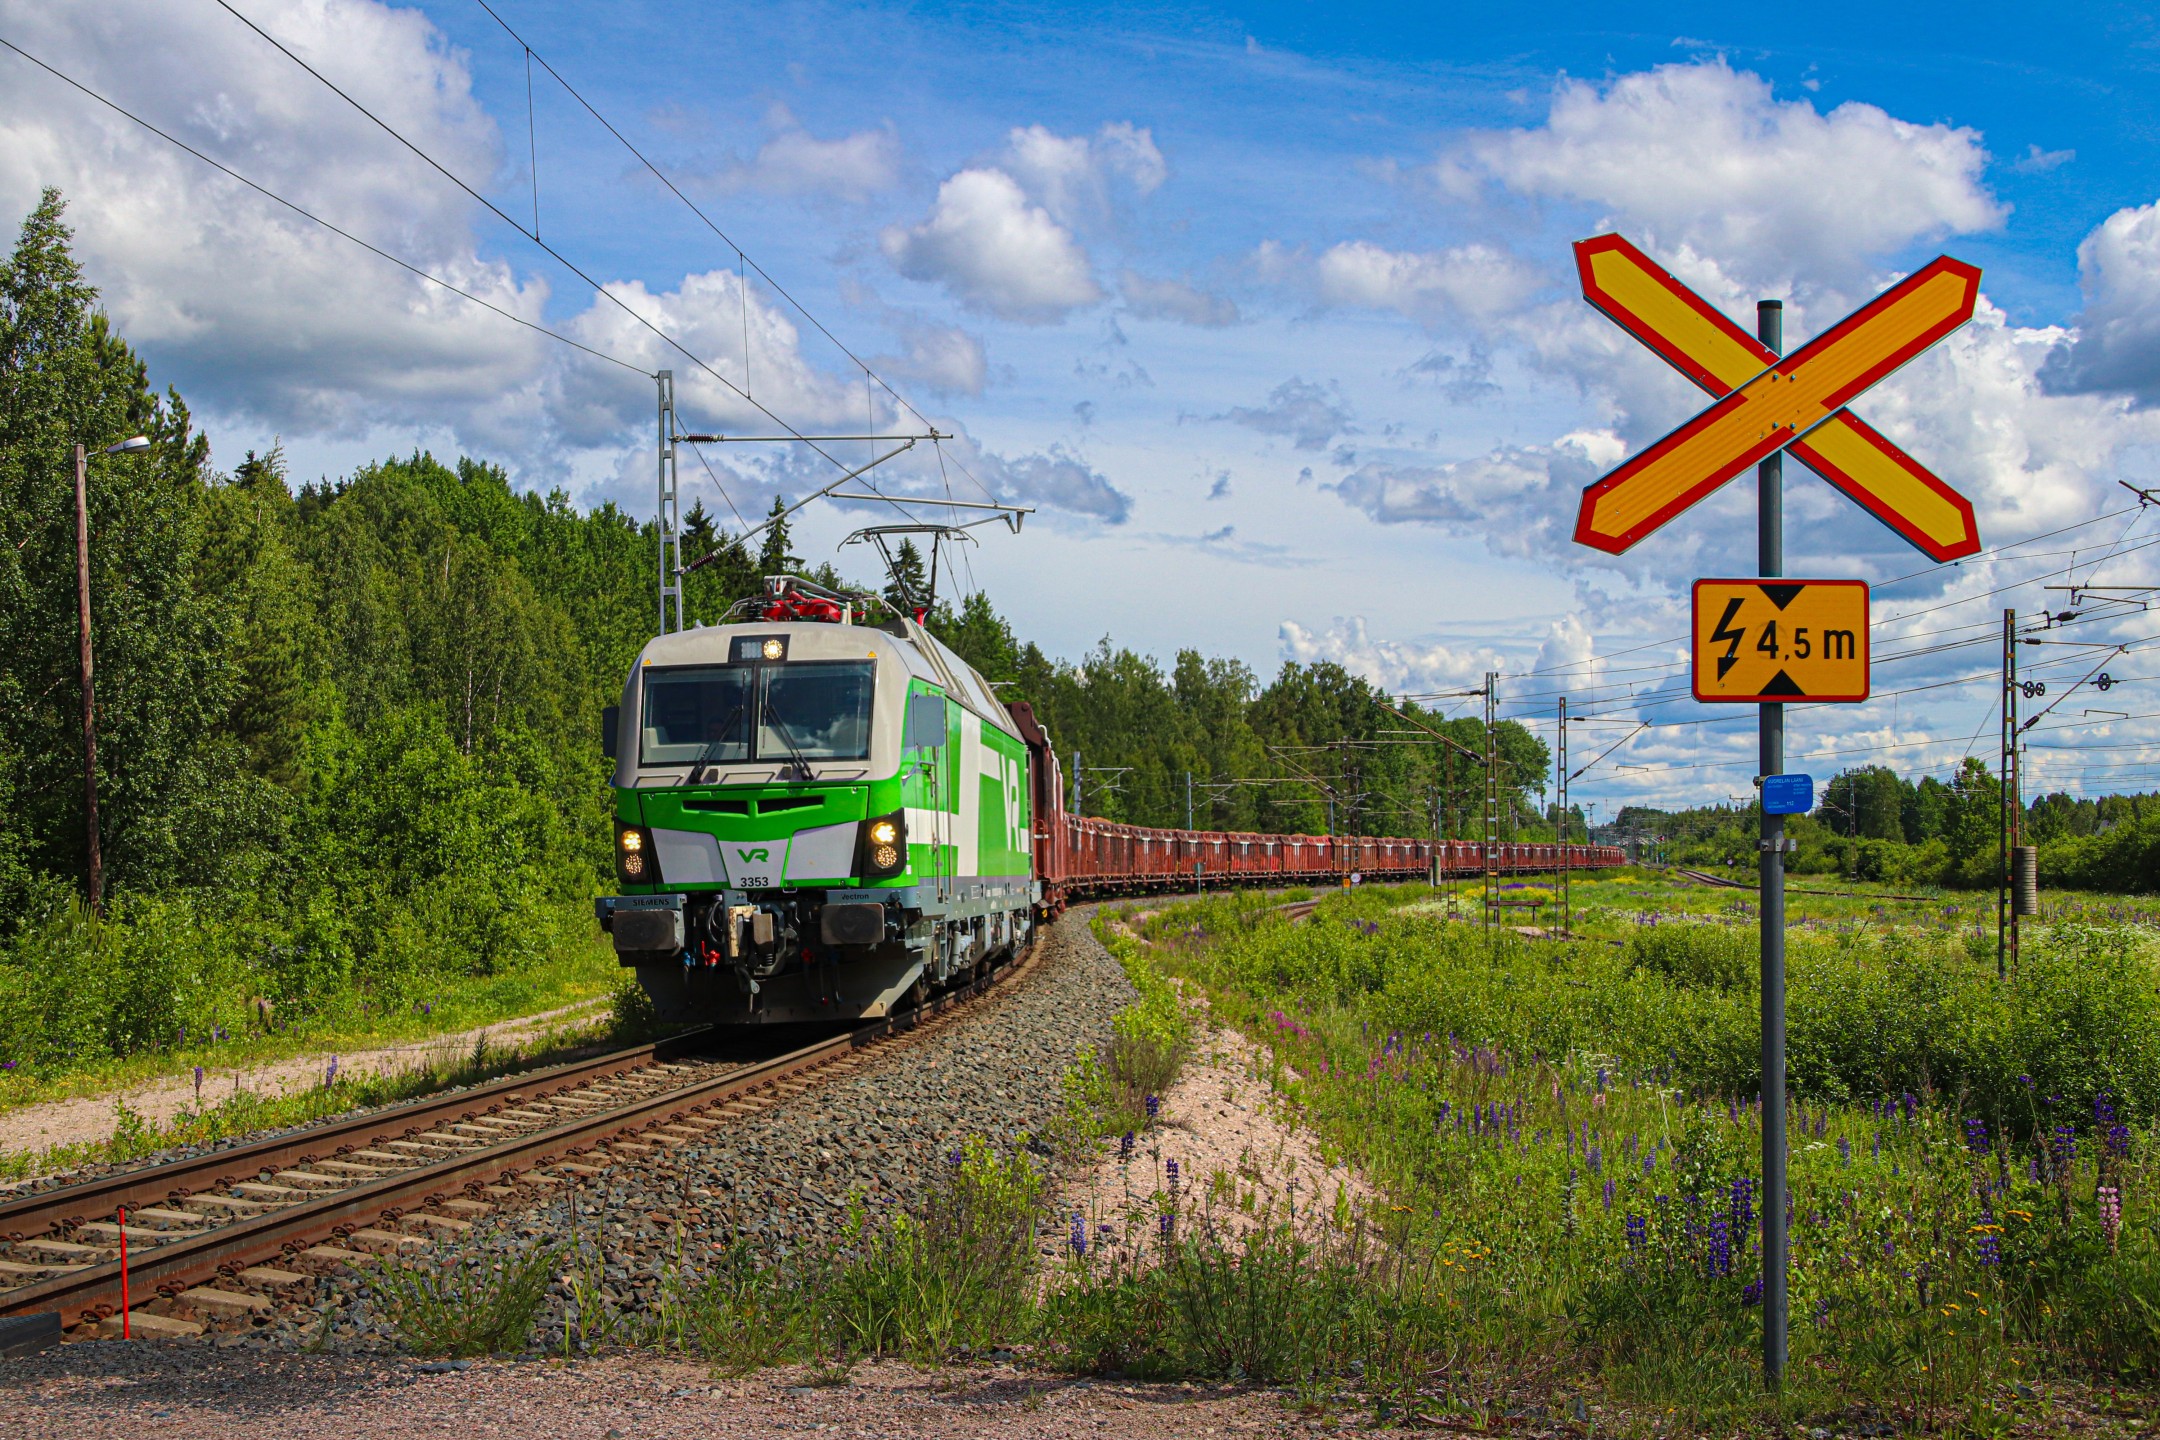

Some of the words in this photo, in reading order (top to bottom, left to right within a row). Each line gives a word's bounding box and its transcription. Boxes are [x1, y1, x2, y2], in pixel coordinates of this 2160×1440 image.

[1757, 620, 1811, 661] 4,5
[1823, 629, 1855, 660] m
[737, 848, 769, 863] VR
[740, 876, 769, 887] 3353
[632, 898, 670, 907] SIEMENS
